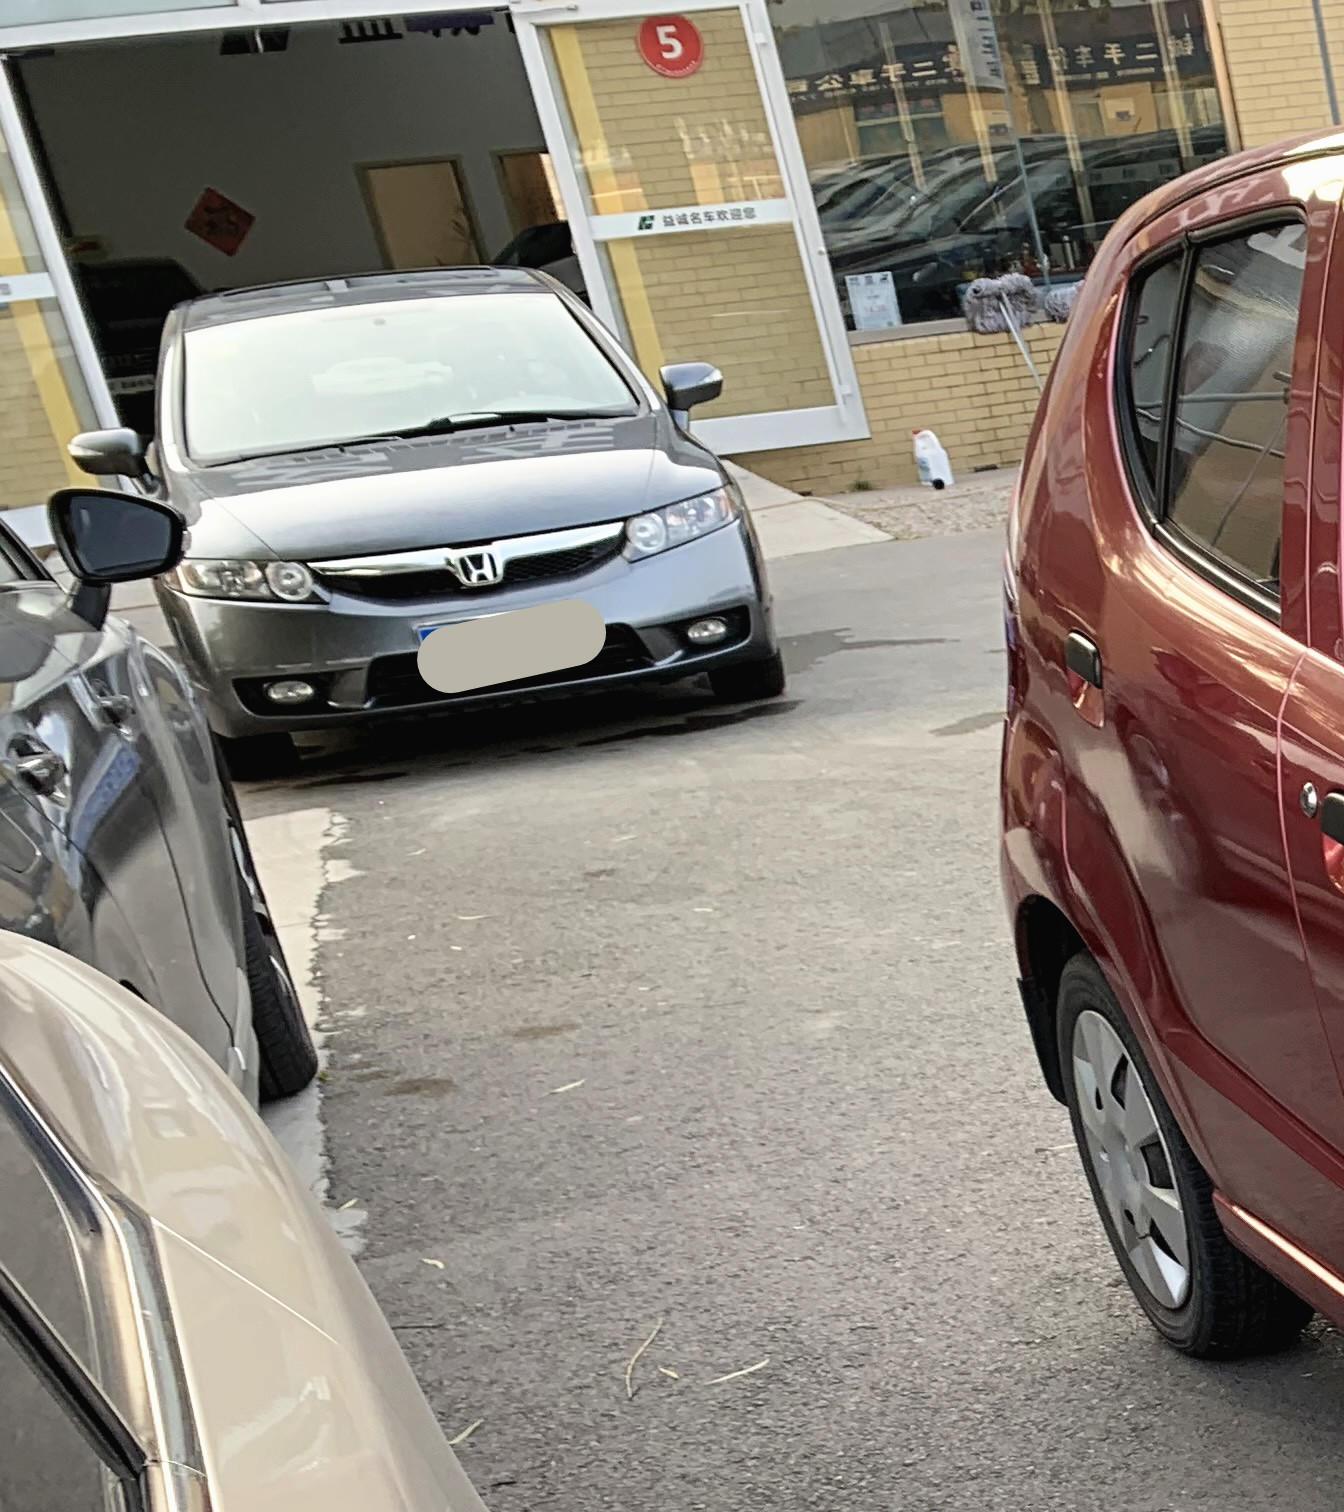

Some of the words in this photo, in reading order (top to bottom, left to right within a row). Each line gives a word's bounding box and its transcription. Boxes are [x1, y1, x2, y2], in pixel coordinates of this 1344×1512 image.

[655, 24, 683, 59] 5
[662, 206, 758, 228] 益诚名车欢迎您
